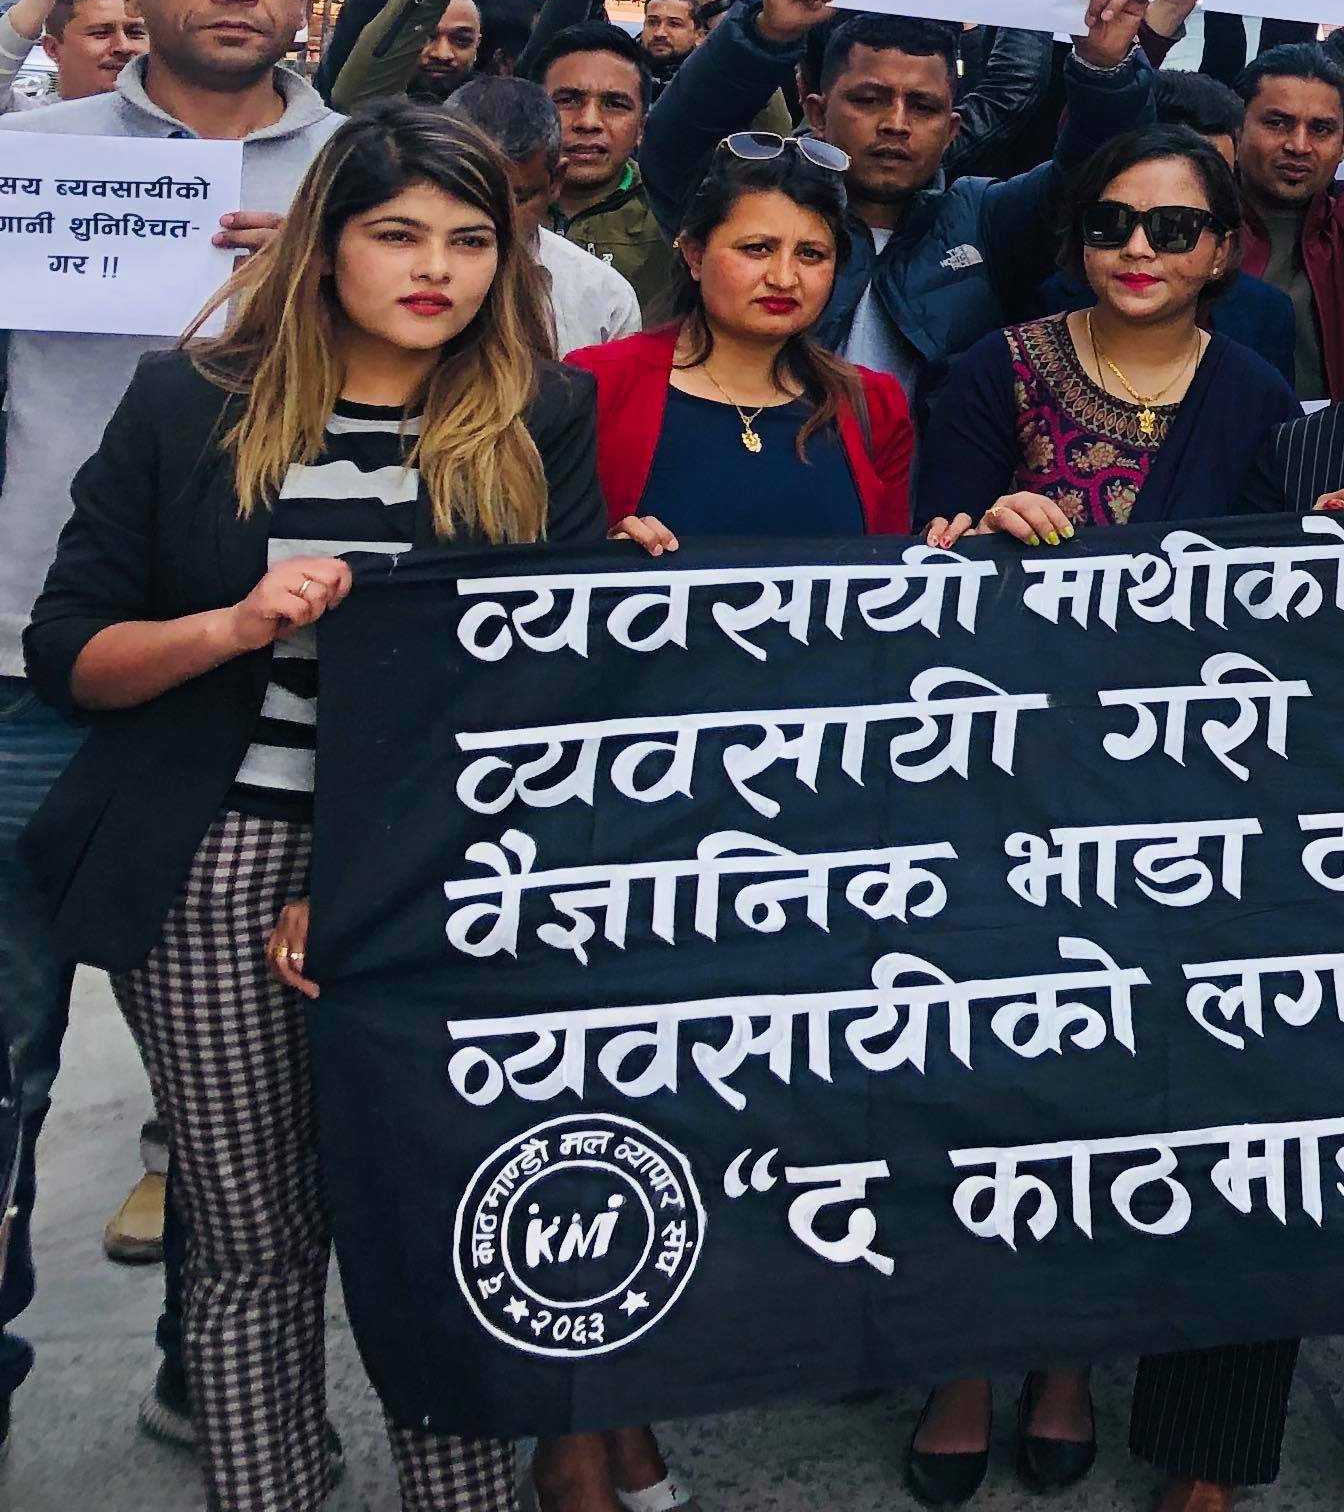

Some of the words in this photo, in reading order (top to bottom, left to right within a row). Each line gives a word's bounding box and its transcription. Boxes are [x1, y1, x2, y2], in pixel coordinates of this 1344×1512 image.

[48, 255, 89, 274] गर
[456, 545, 998, 662] व्यवसायी
[455, 667, 1050, 818] व्यवसायी
[1099, 652, 1311, 782] गरी
[444, 828, 958, 965] वैज्ञानिक
[1005, 818, 1262, 908] भाडा
[446, 937, 1152, 1111] व्यवसायीको
[560, 1131, 615, 1155] मल
[531, 1310, 605, 1344] २०६३
